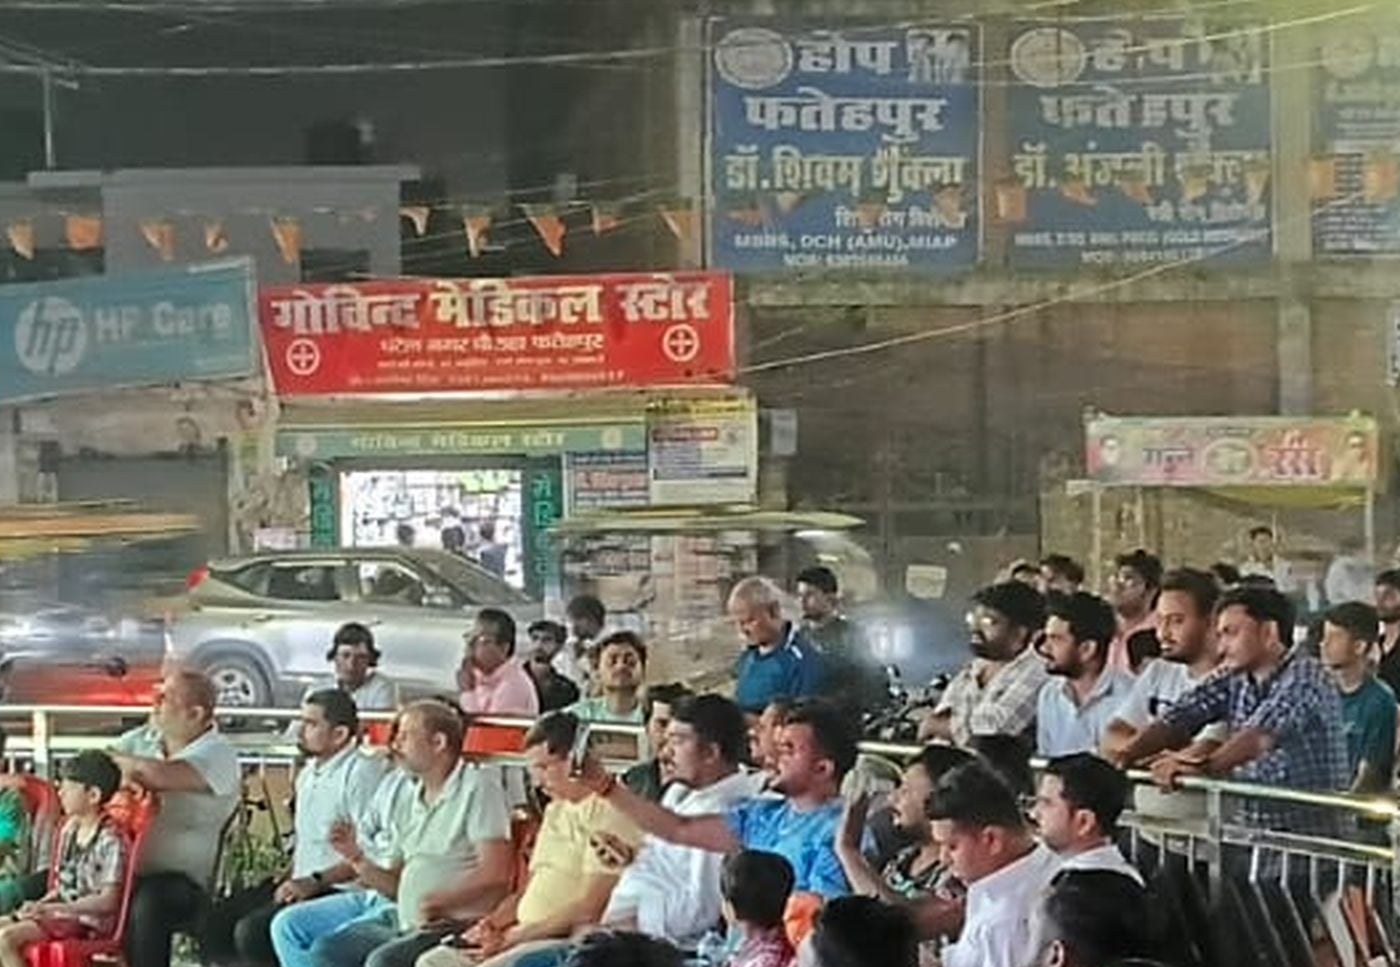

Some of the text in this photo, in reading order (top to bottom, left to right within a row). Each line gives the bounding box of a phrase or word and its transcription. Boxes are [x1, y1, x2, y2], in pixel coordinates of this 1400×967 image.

[743, 86, 947, 143] फतेहपुर
[270, 274, 711, 334] गोविन्द मेडिकल स्टोर
[21, 300, 82, 375] hp
